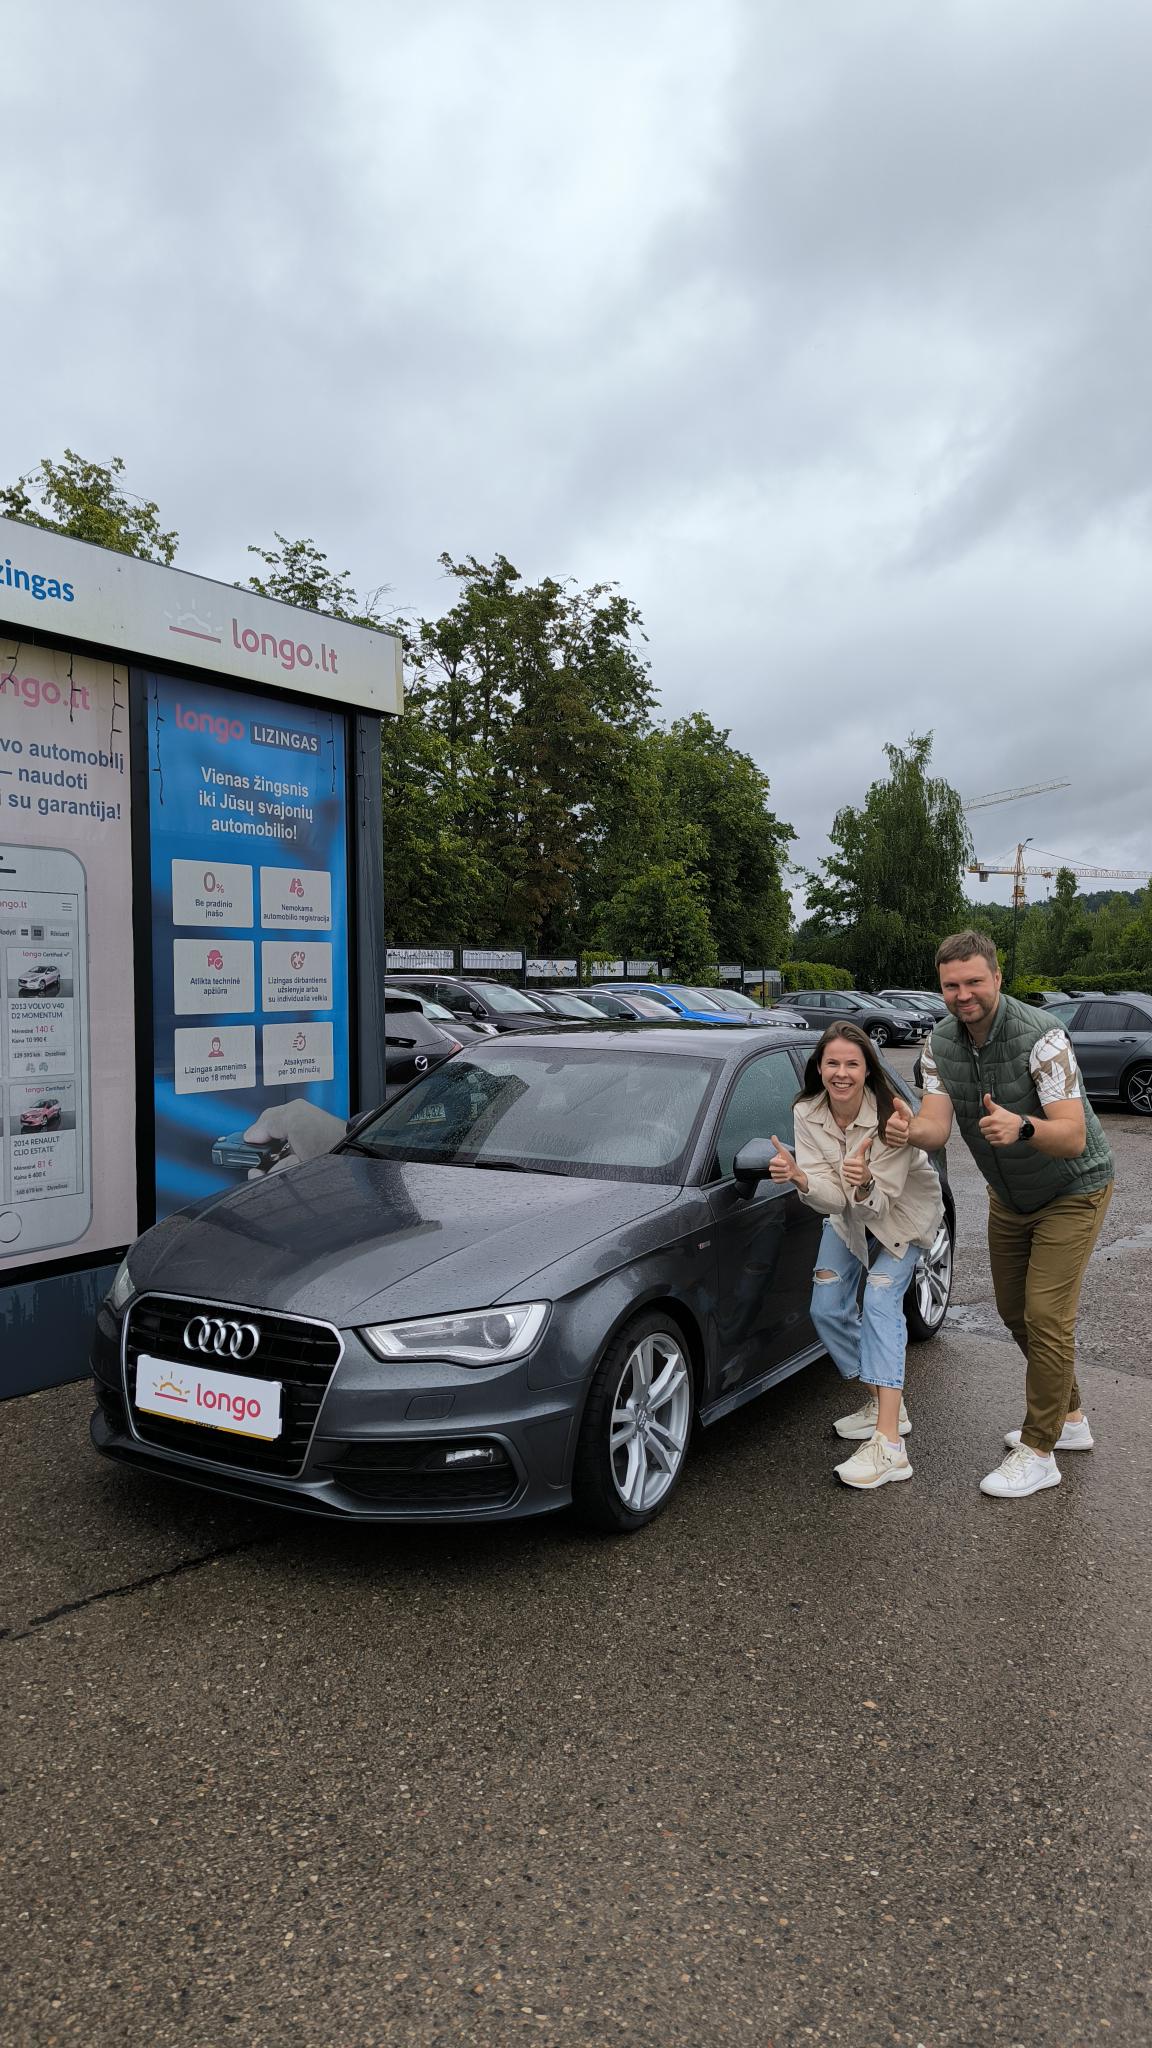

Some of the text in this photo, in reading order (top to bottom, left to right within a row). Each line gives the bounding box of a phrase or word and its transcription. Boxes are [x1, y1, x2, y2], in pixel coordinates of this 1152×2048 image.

[232, 618, 338, 674] longo.lt
[176, 703, 318, 751] longo LIZINGAS
[29, 743, 124, 774] automobilį
[19, 768, 88, 790] naudoti
[201, 766, 309, 797] Vienas žingsnis
[8, 793, 31, 809] su
[38, 798, 121, 822] garantija!
[199, 790, 313, 823] iki Jūsų svajonių
[211, 818, 297, 839] automobilio!
[203, 872, 224, 893] 0%
[0, 900, 27, 910] ngo.lt
[195, 899, 233, 911] Be pradinio
[281, 904, 313, 912] Nemokama
[263, 913, 330, 923] automobilio registracija
[190, 976, 240, 985] Atlikta techninė
[268, 976, 327, 986] Lizingas dirbantiems
[28, 1002, 51, 1010] VOLVO
[22, 1011, 63, 1019] MOMENTUM
[35, 1025, 49, 1033] 140
[284, 1058, 316, 1067] Atsakymas
[184, 1063, 247, 1075] Lizingas asmenims
[278, 1068, 288, 1076] per
[220, 1073, 236, 1082] metų
[14, 1136, 60, 1148] 2014 RENAULT
[14, 1146, 55, 1157] CLIO ESTATE
[196, 1383, 261, 1421] longo
